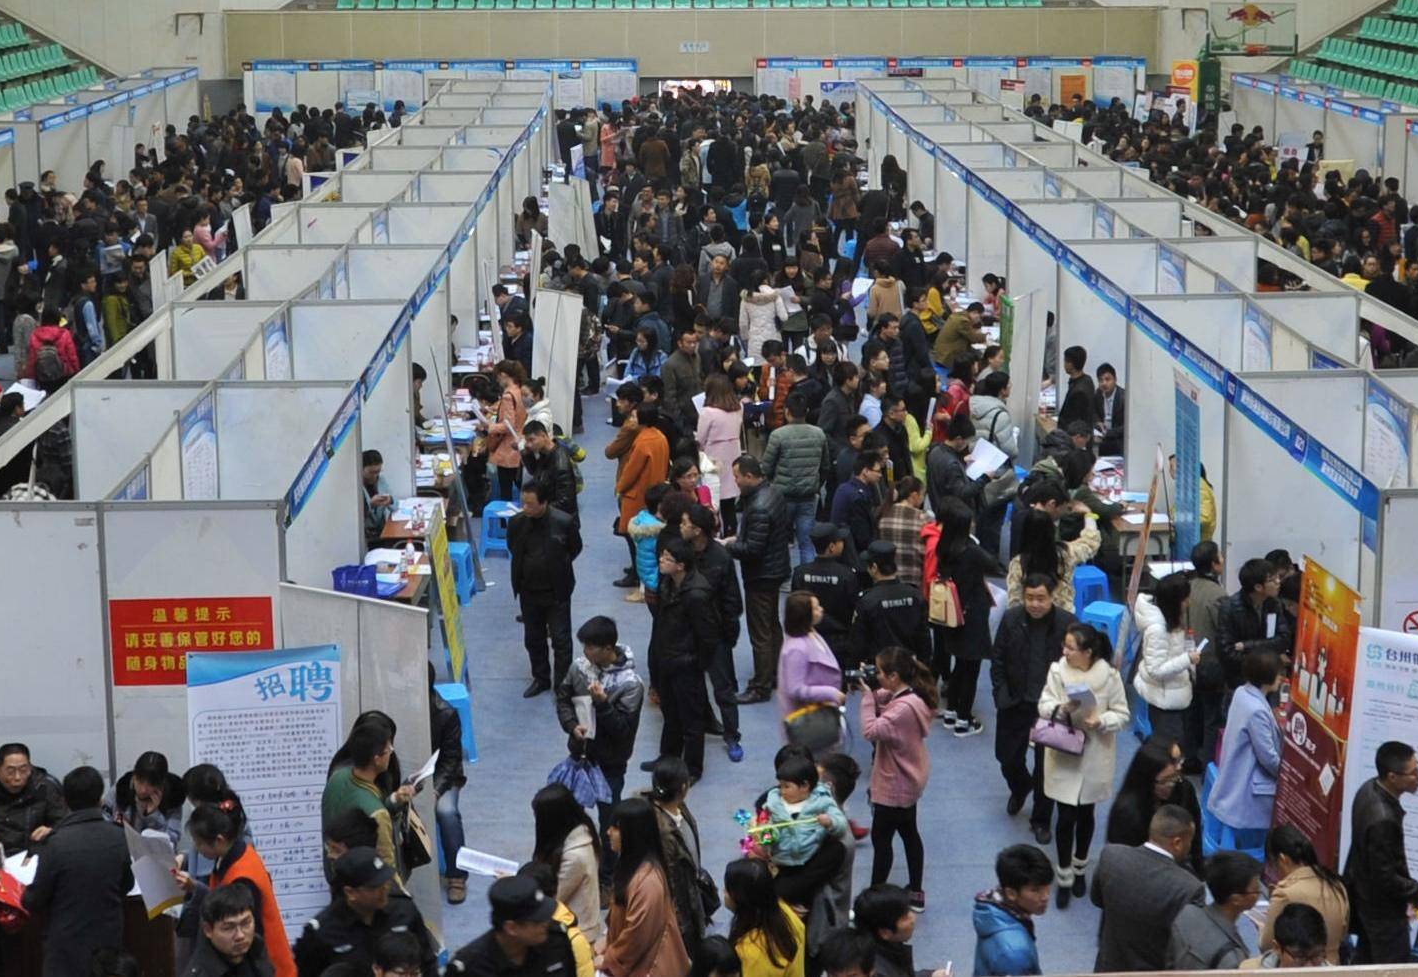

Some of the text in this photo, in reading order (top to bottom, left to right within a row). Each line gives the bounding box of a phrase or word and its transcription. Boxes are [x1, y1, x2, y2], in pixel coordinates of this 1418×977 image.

[152, 607, 232, 623] 温馨提示
[125, 631, 262, 648] 请妥善保管好您的
[254, 661, 334, 703] 招聘
